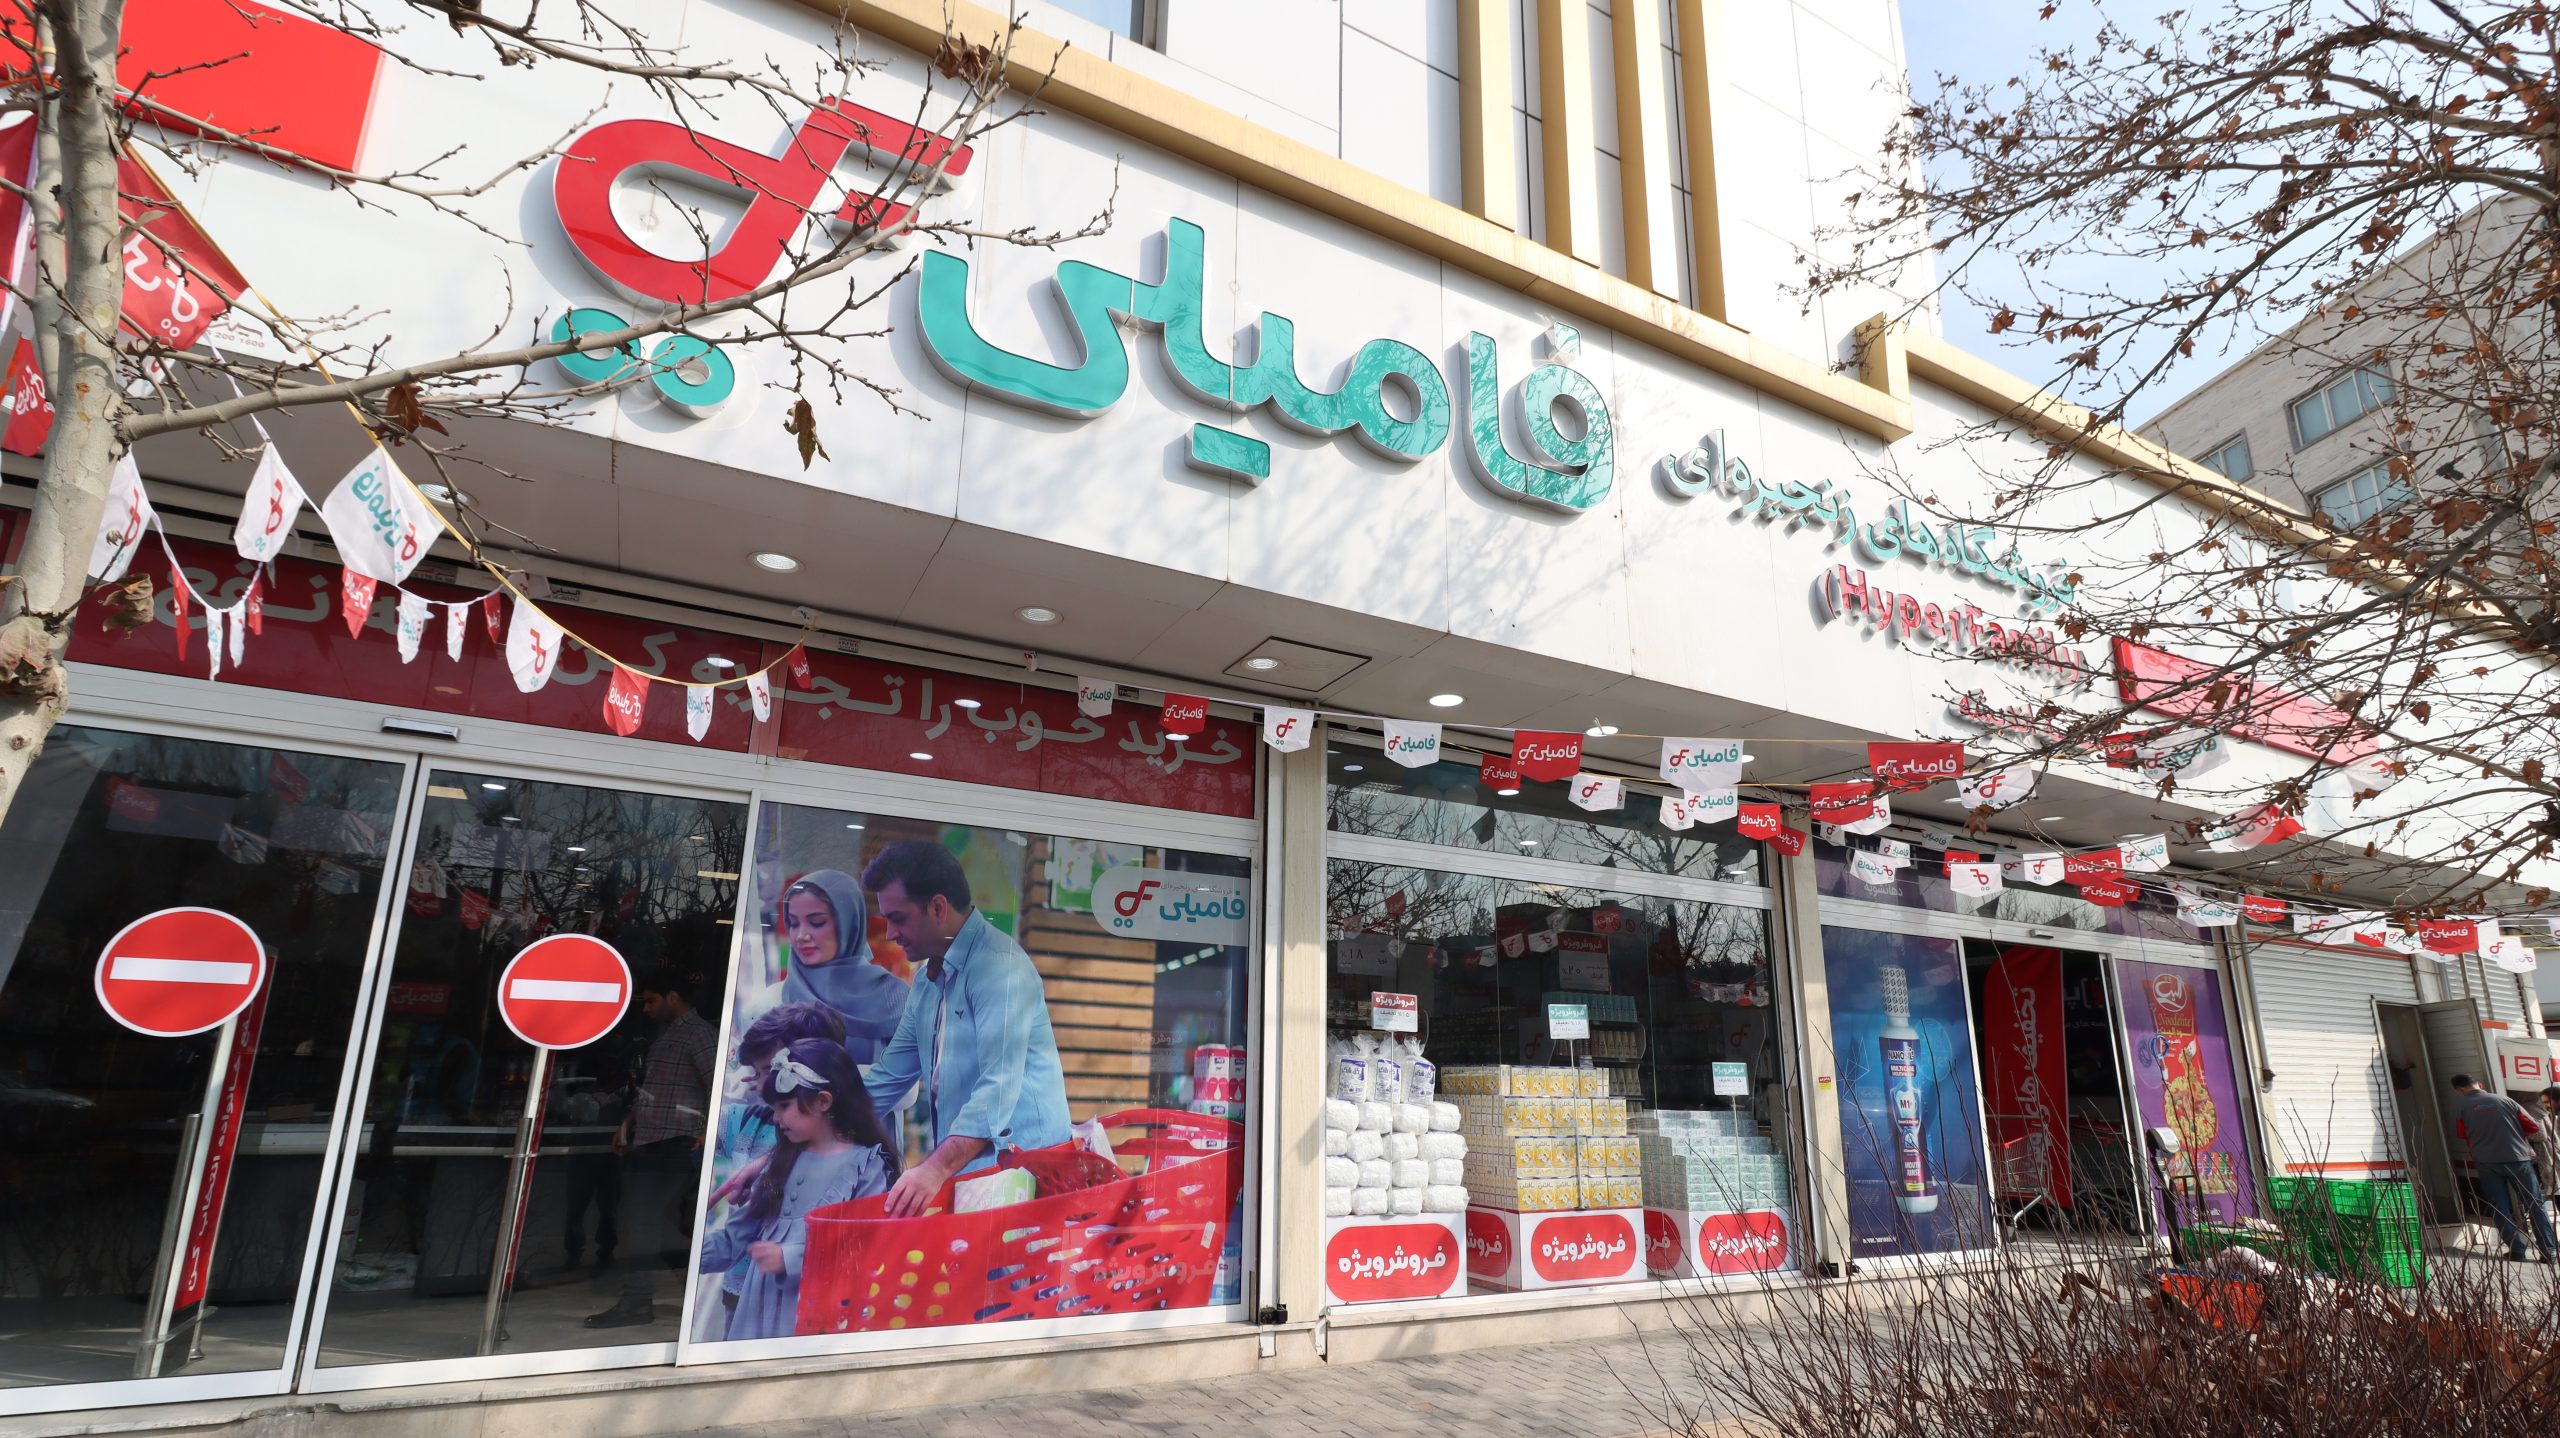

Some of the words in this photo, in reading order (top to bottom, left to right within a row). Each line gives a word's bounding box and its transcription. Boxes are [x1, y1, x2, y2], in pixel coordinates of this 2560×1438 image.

[917, 217, 1613, 512] فامیلی
[919, 677, 952, 741] را
[1172, 702, 1204, 721] فامیلی
[1398, 734, 1436, 753] فامیلی
[1532, 741, 1579, 760] فامیلی
[1686, 743, 1739, 768] فامیلی
[1892, 753, 1957, 774] فامیلی
[1698, 791, 1735, 809] فامیلی
[1159, 889, 1246, 922] فامیلی
[2432, 925, 2469, 938] فامیلی
[1541, 1235, 1579, 1263] ویژه
[1577, 1232, 1626, 1261] فروش
[1338, 1248, 1385, 1280] ویژه
[1383, 1245, 1447, 1277] فروش
